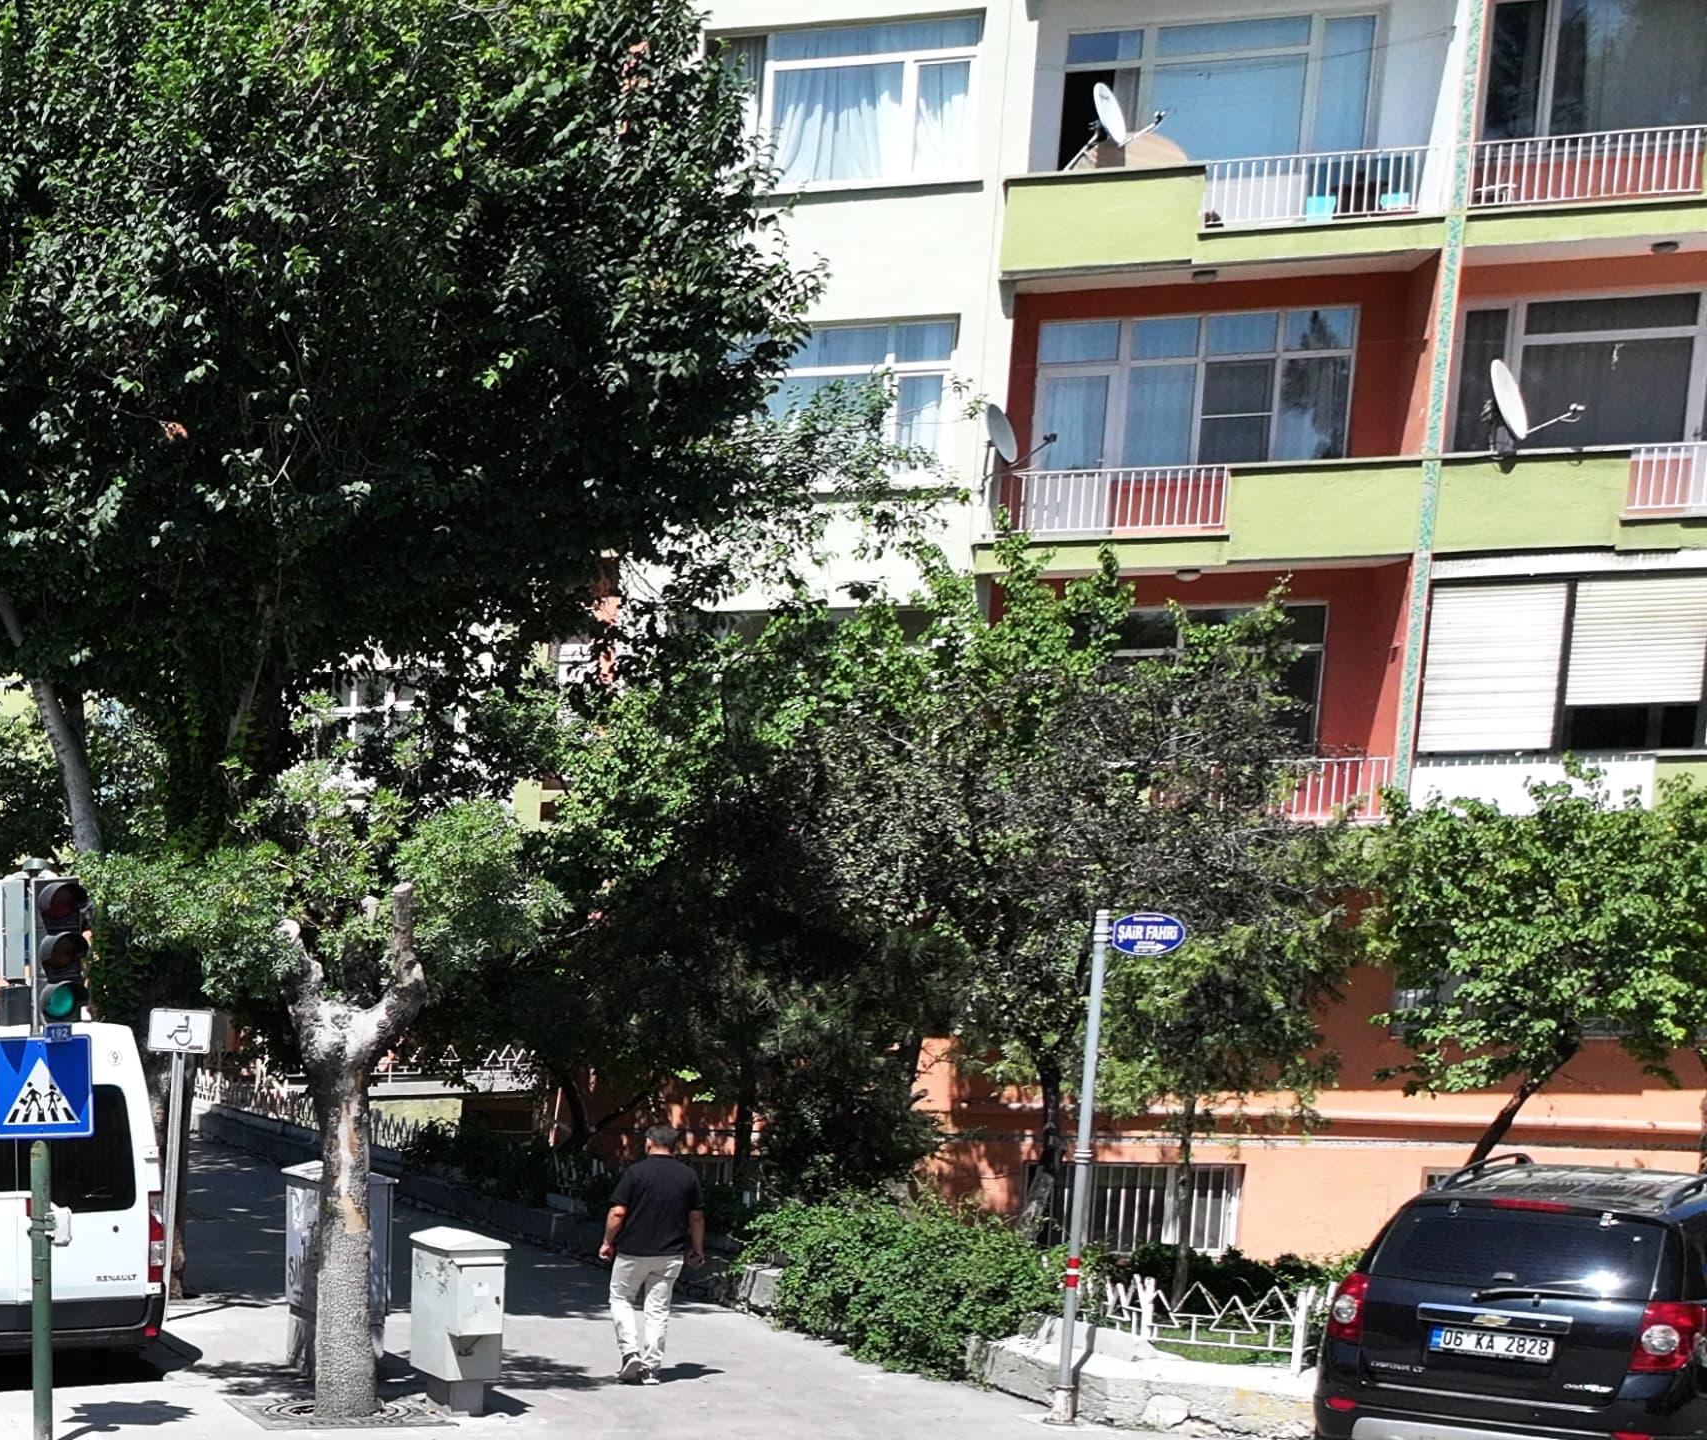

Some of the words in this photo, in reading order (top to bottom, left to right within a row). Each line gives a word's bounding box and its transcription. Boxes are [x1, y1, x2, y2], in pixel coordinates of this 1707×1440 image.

[49, 1027, 69, 1039] 192
[95, 1273, 138, 1282] RENAULT
[1442, 1330, 1464, 1348] 06
[1474, 1333, 1496, 1352] KA
[1504, 1337, 1550, 1357] 2828
